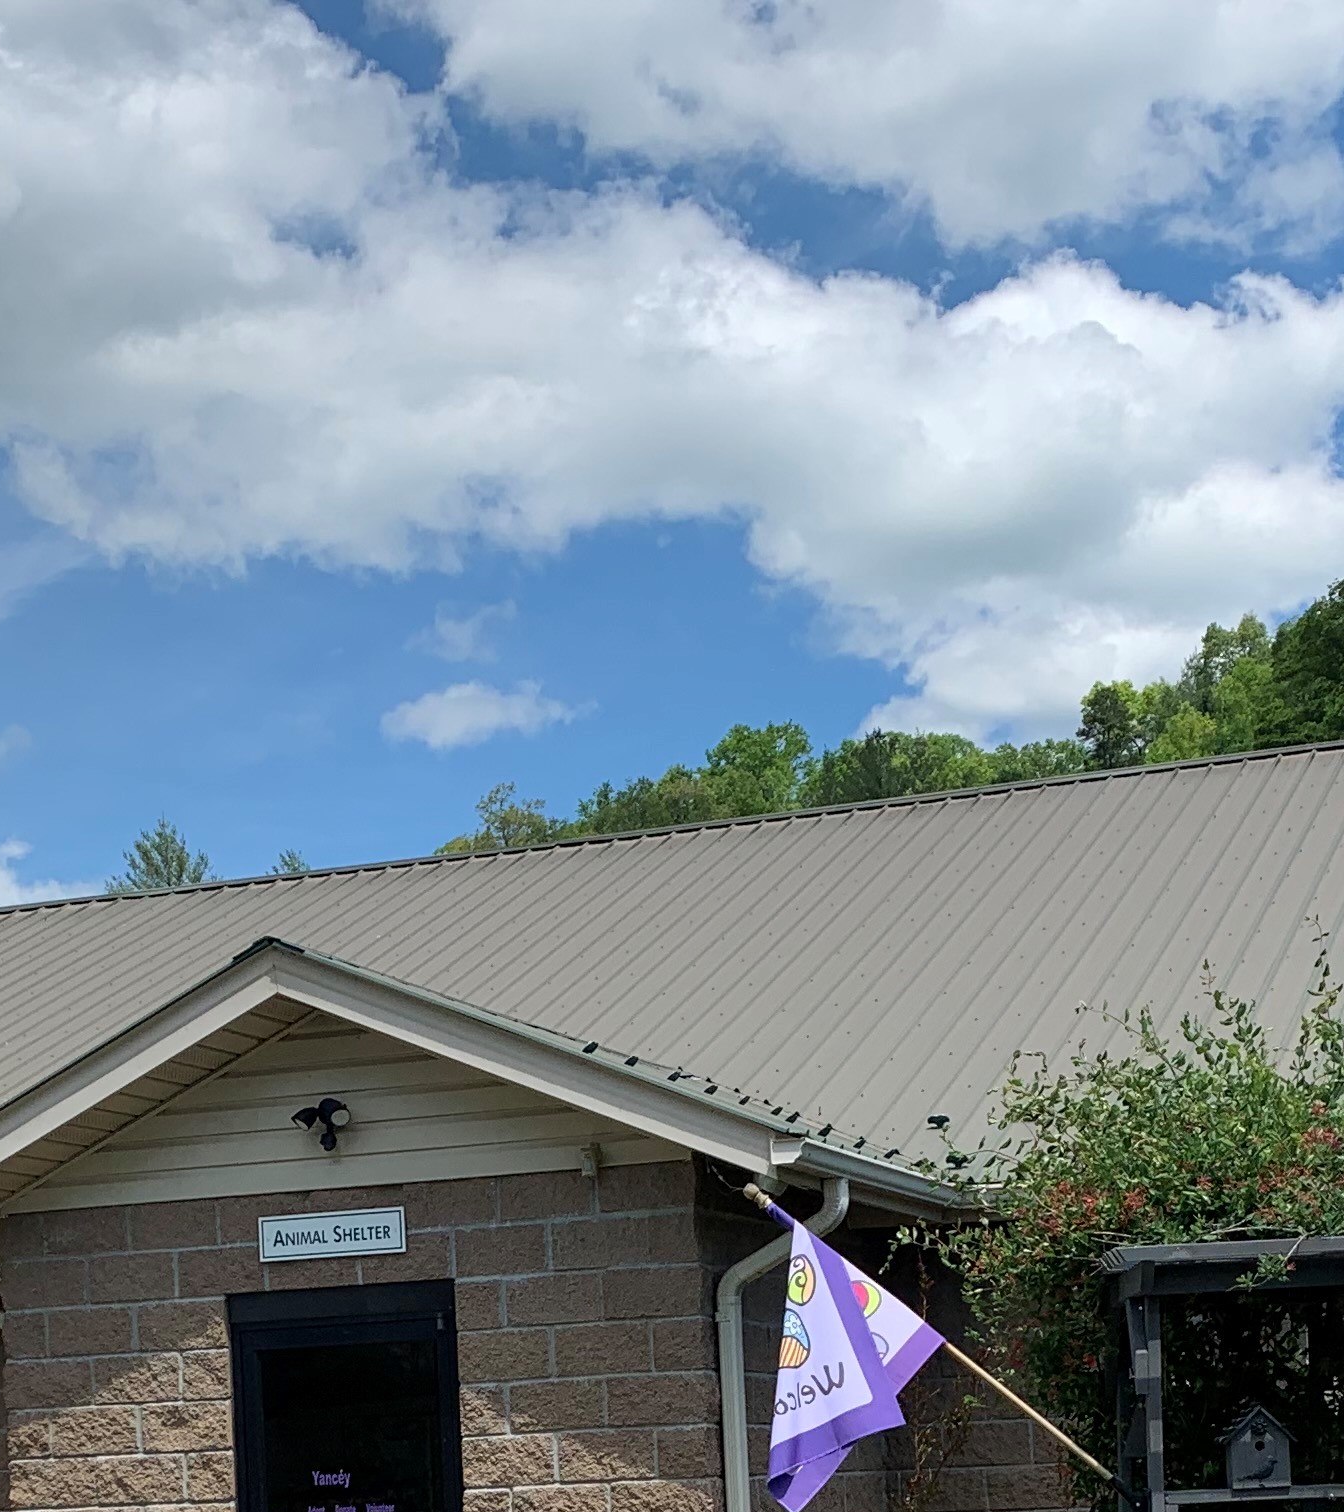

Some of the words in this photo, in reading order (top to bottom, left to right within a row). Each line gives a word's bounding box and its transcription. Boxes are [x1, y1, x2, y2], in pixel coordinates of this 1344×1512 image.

[273, 1230, 328, 1247] ANIMAL
[333, 1225, 391, 1243] SHELTER
[311, 1470, 351, 1488] Yancey
[366, 1503, 395, 1512] Volunteer
